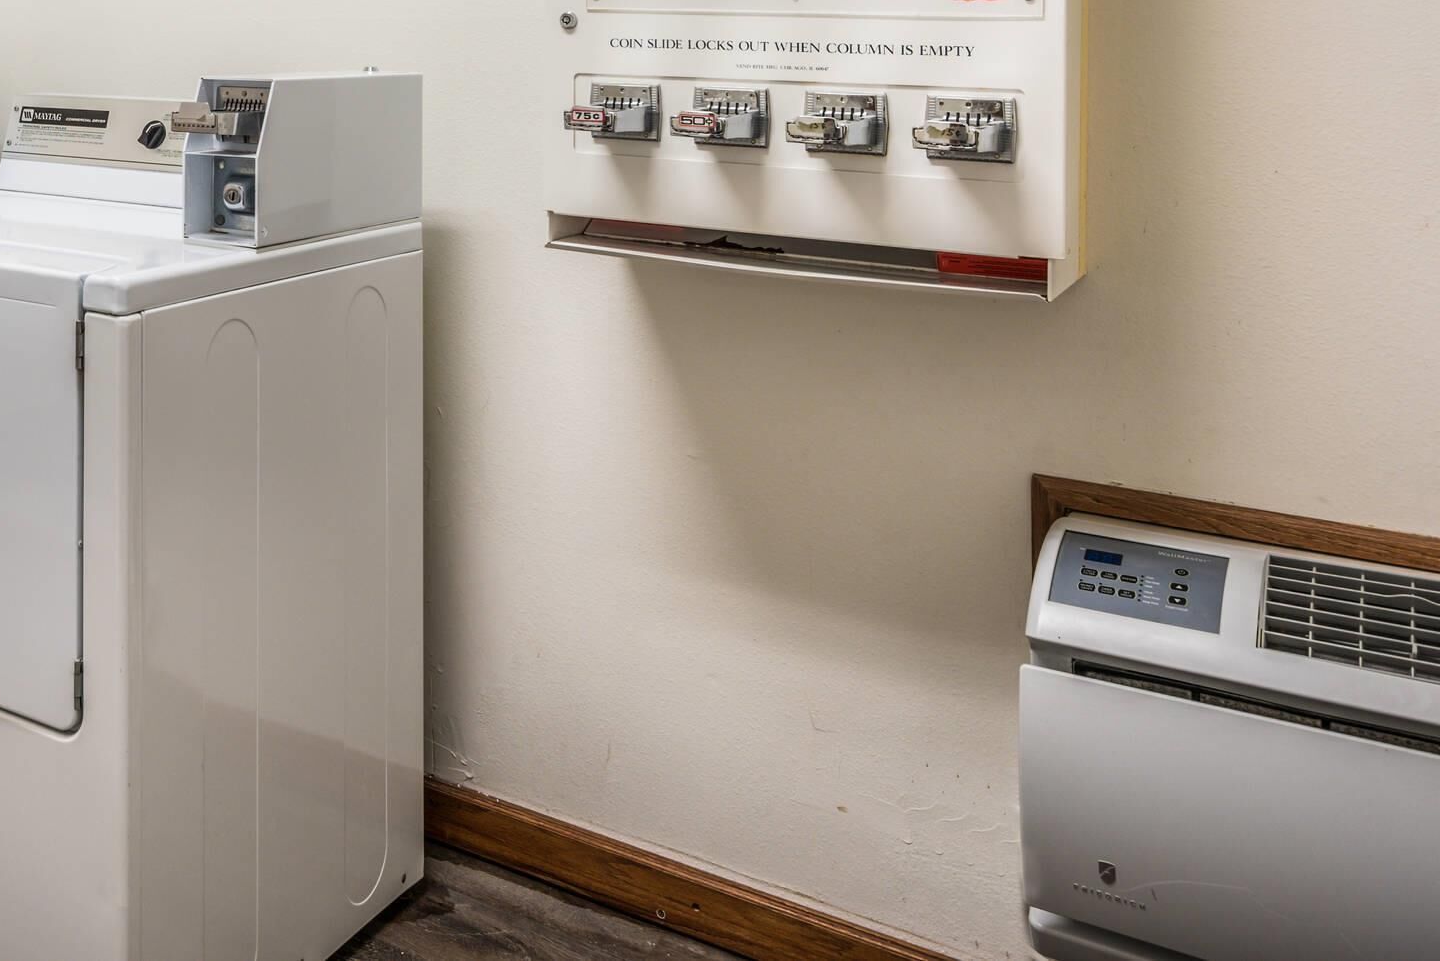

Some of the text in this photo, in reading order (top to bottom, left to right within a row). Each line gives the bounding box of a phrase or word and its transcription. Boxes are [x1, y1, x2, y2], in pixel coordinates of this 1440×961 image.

[610, 38, 975, 57] COIN SLIDE LOCKS OUT WHEN COLUMN IS EMPTY
[33, 111, 62, 122] MAYTAG
[681, 116, 713, 126] 50¢
